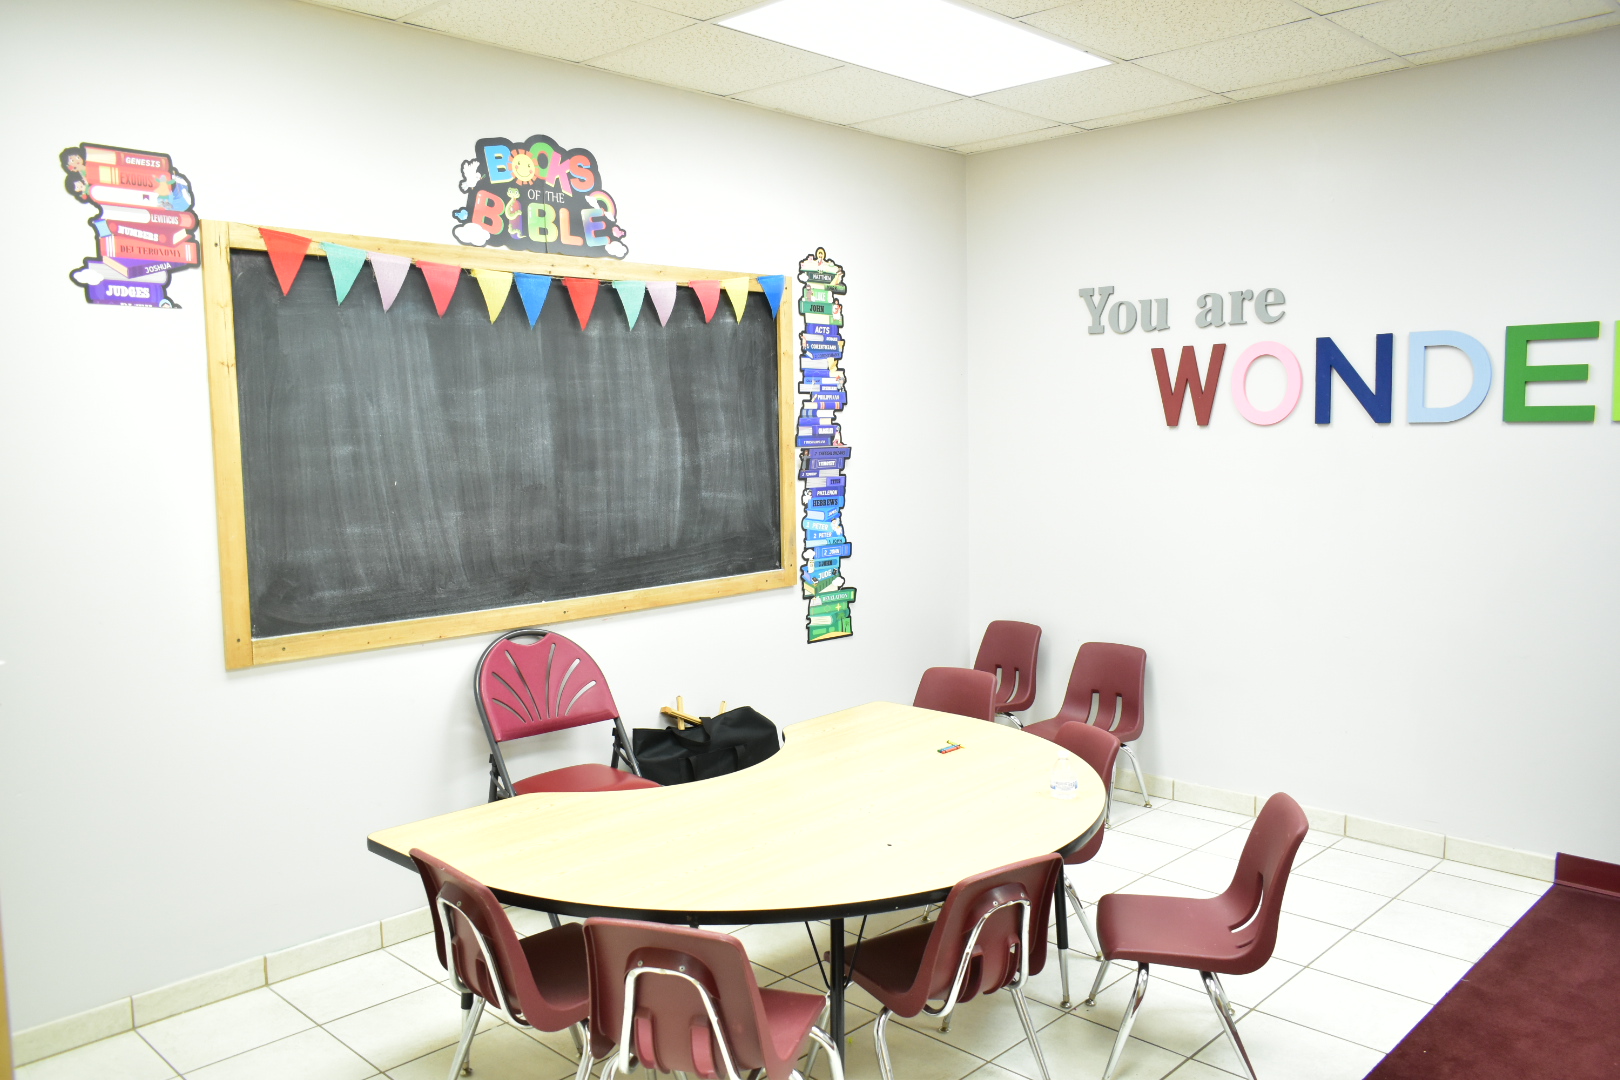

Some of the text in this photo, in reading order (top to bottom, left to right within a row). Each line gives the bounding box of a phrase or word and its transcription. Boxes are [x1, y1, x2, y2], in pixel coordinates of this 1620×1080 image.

[125, 156, 161, 168] GENESIS
[484, 142, 595, 197] BOOKS
[120, 172, 154, 188] EXODUS
[528, 189, 565, 203] OF THE
[150, 213, 179, 225] LEVITICUS
[472, 189, 611, 247] BIBLE
[117, 225, 159, 242] NUMBERS
[145, 262, 172, 274] JOSHUA
[105, 284, 151, 299] JUDGES
[810, 305, 824, 313] JOHN
[1079, 286, 1286, 335] You are
[815, 326, 830, 334] ACTS
[1150, 320, 1620, 428] WONDE
[813, 499, 838, 507] HEBREWS
[812, 522, 829, 530] PETER
[818, 531, 832, 539] PETER
[818, 569, 833, 579] JUDE
